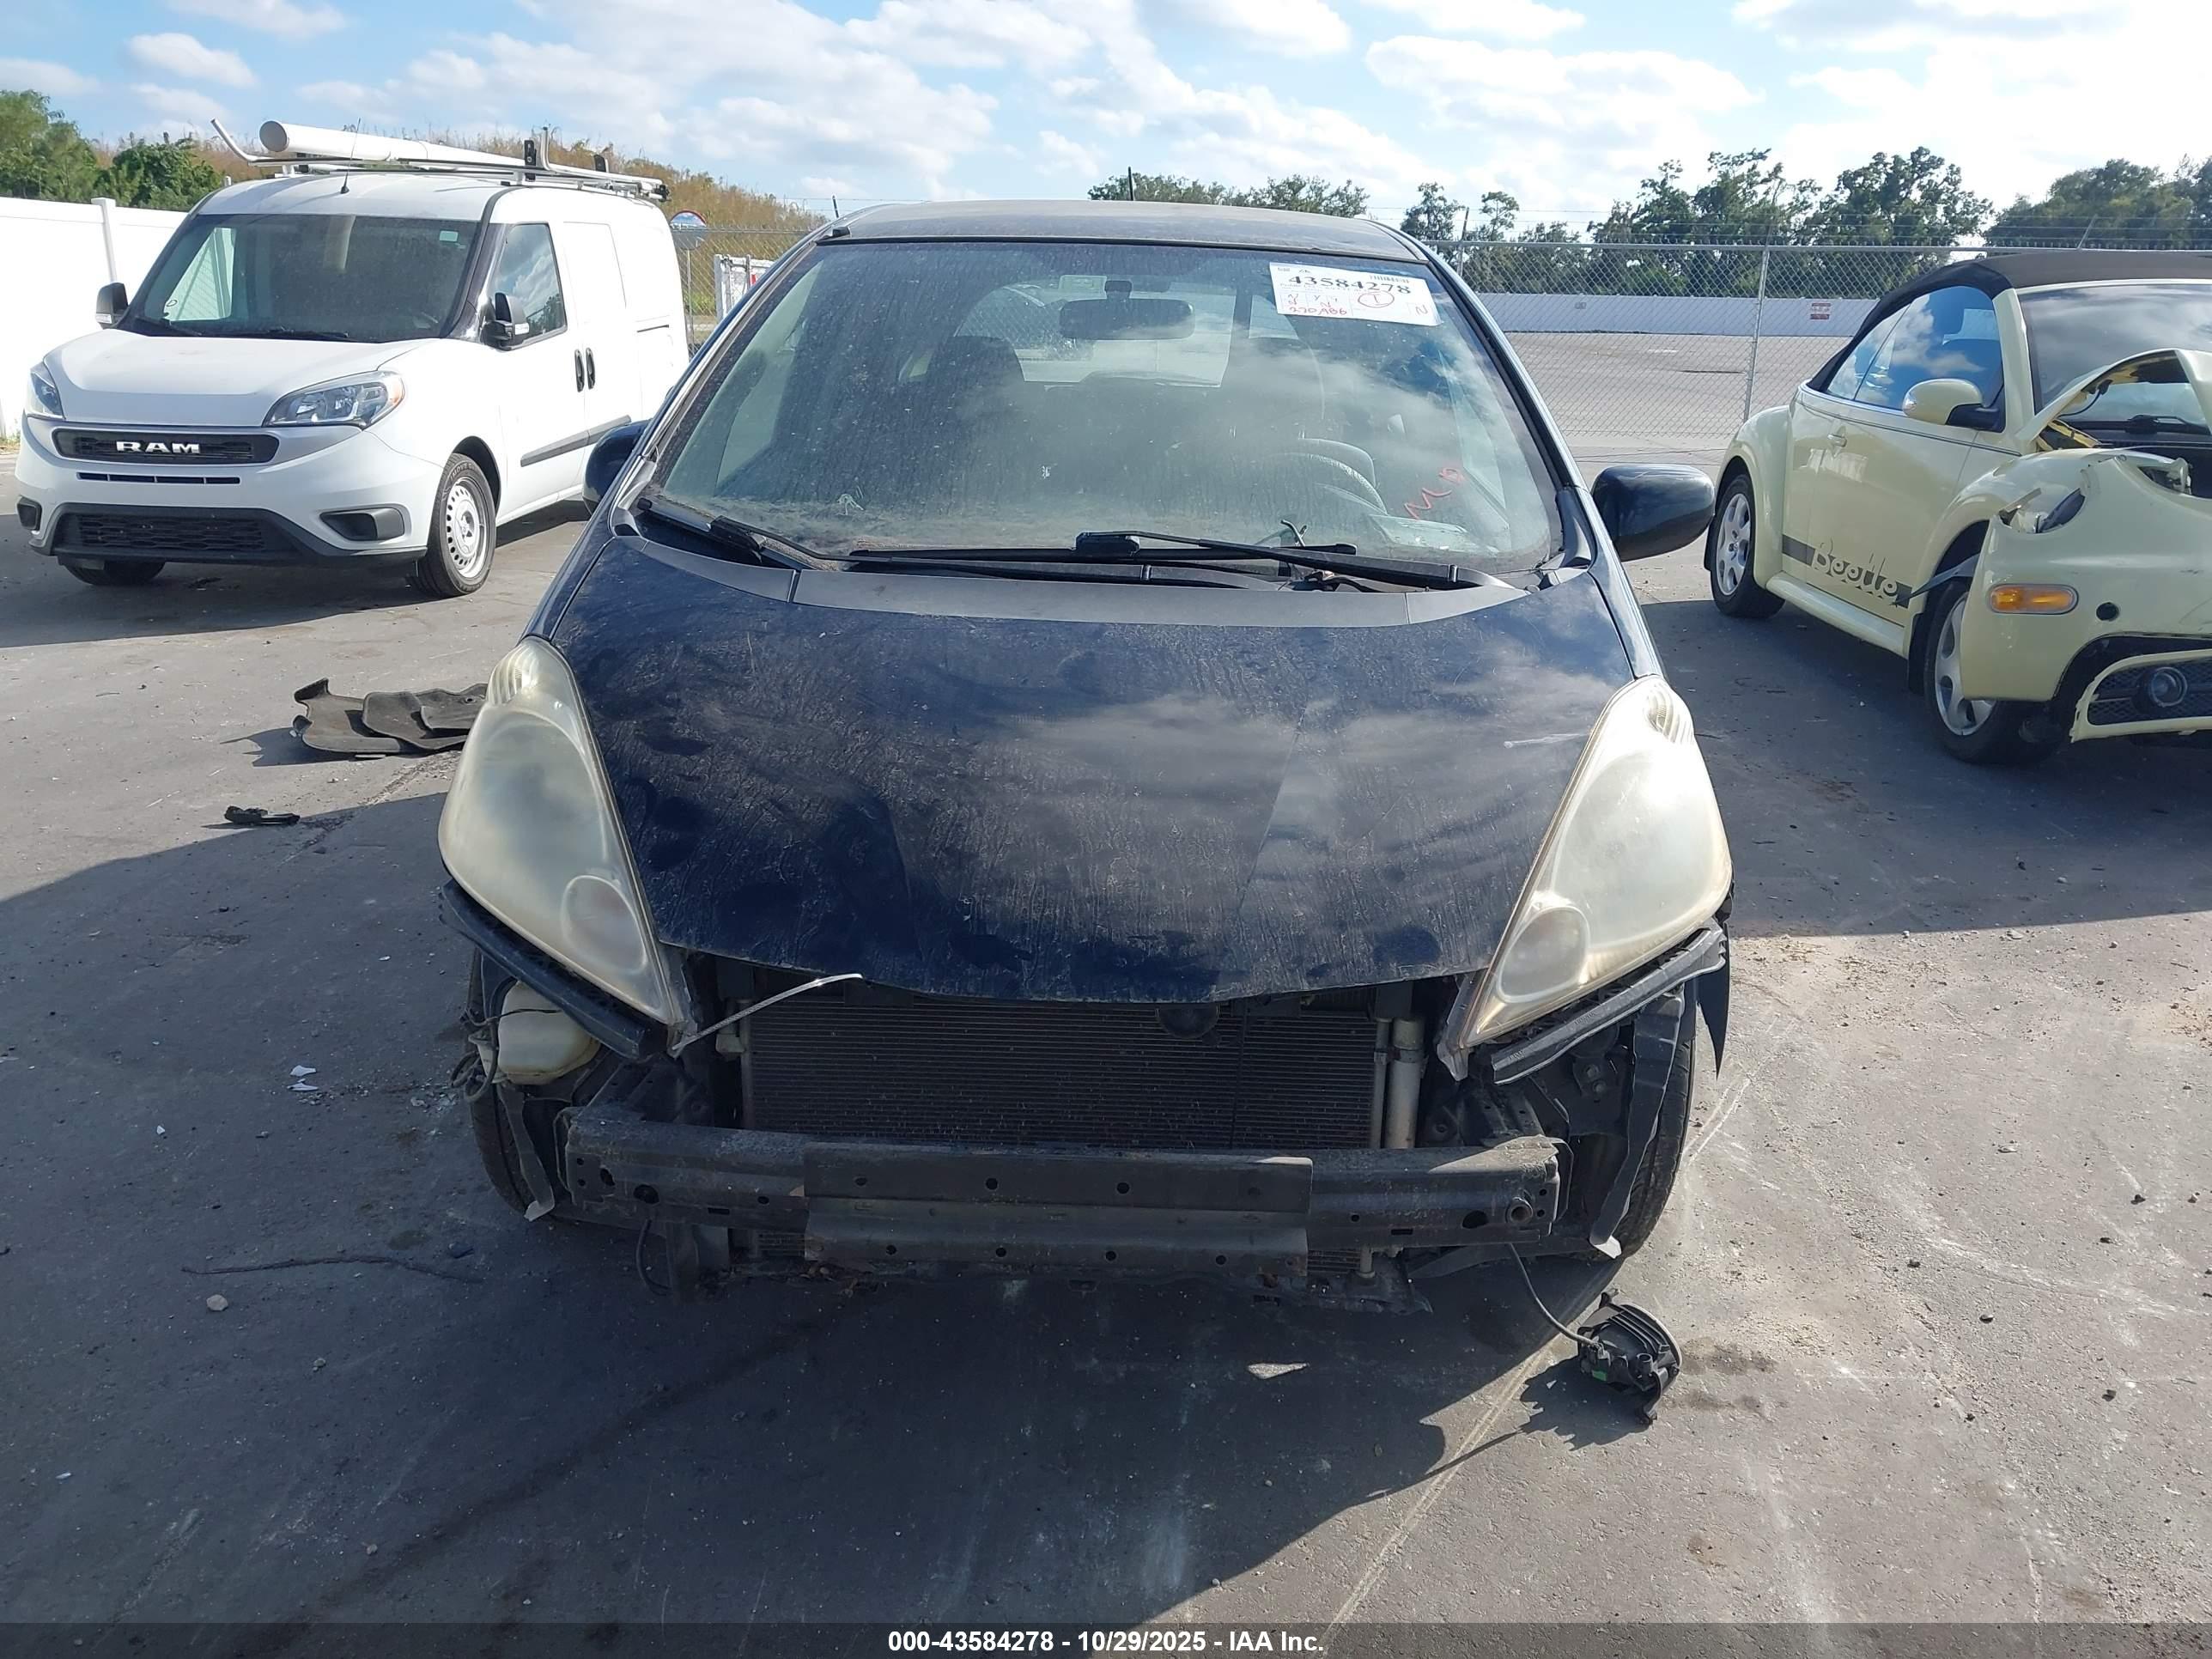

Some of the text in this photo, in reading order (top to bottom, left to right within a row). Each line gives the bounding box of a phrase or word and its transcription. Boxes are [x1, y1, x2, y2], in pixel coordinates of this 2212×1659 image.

[1288, 276, 1411, 294] 43584278
[116, 441, 201, 454] RAM
[1812, 538, 1899, 605] Beetle
